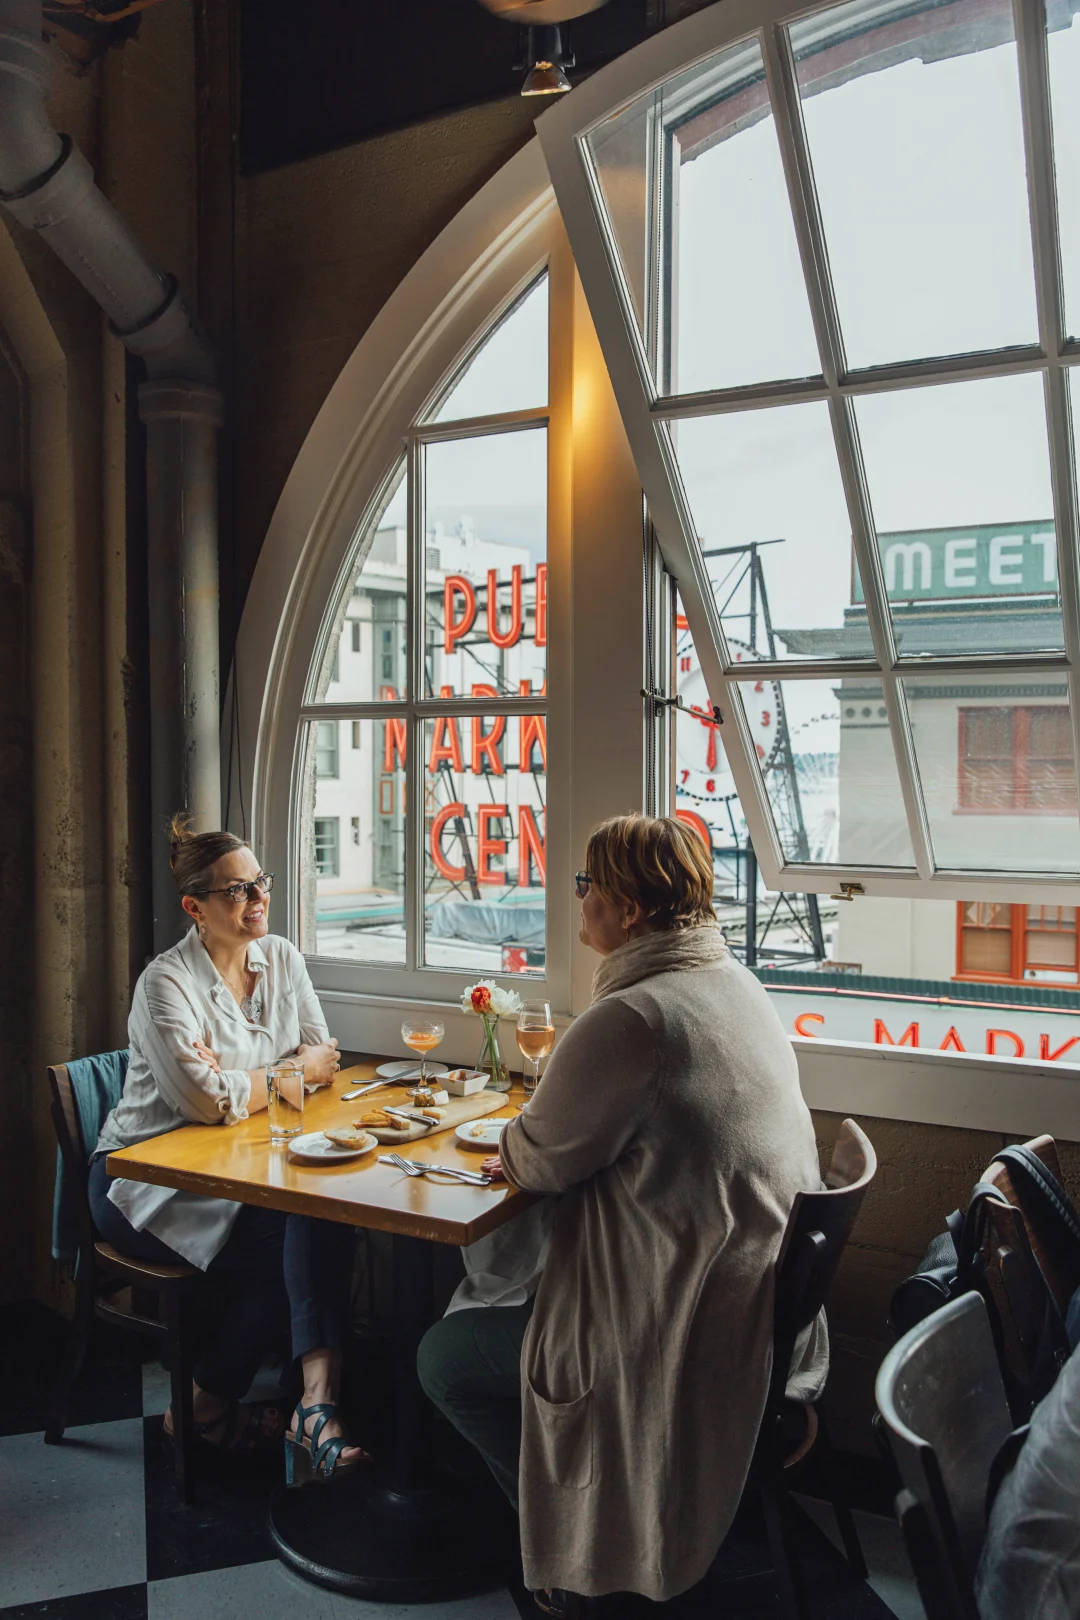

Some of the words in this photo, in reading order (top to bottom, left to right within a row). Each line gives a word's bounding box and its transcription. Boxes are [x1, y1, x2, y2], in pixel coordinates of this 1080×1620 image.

[885, 531, 1056, 592] MEET
[680, 656, 691, 673] 11
[761, 710, 771, 728] 3
[681, 769, 690, 785] 7
[706, 778, 716, 793] 6
